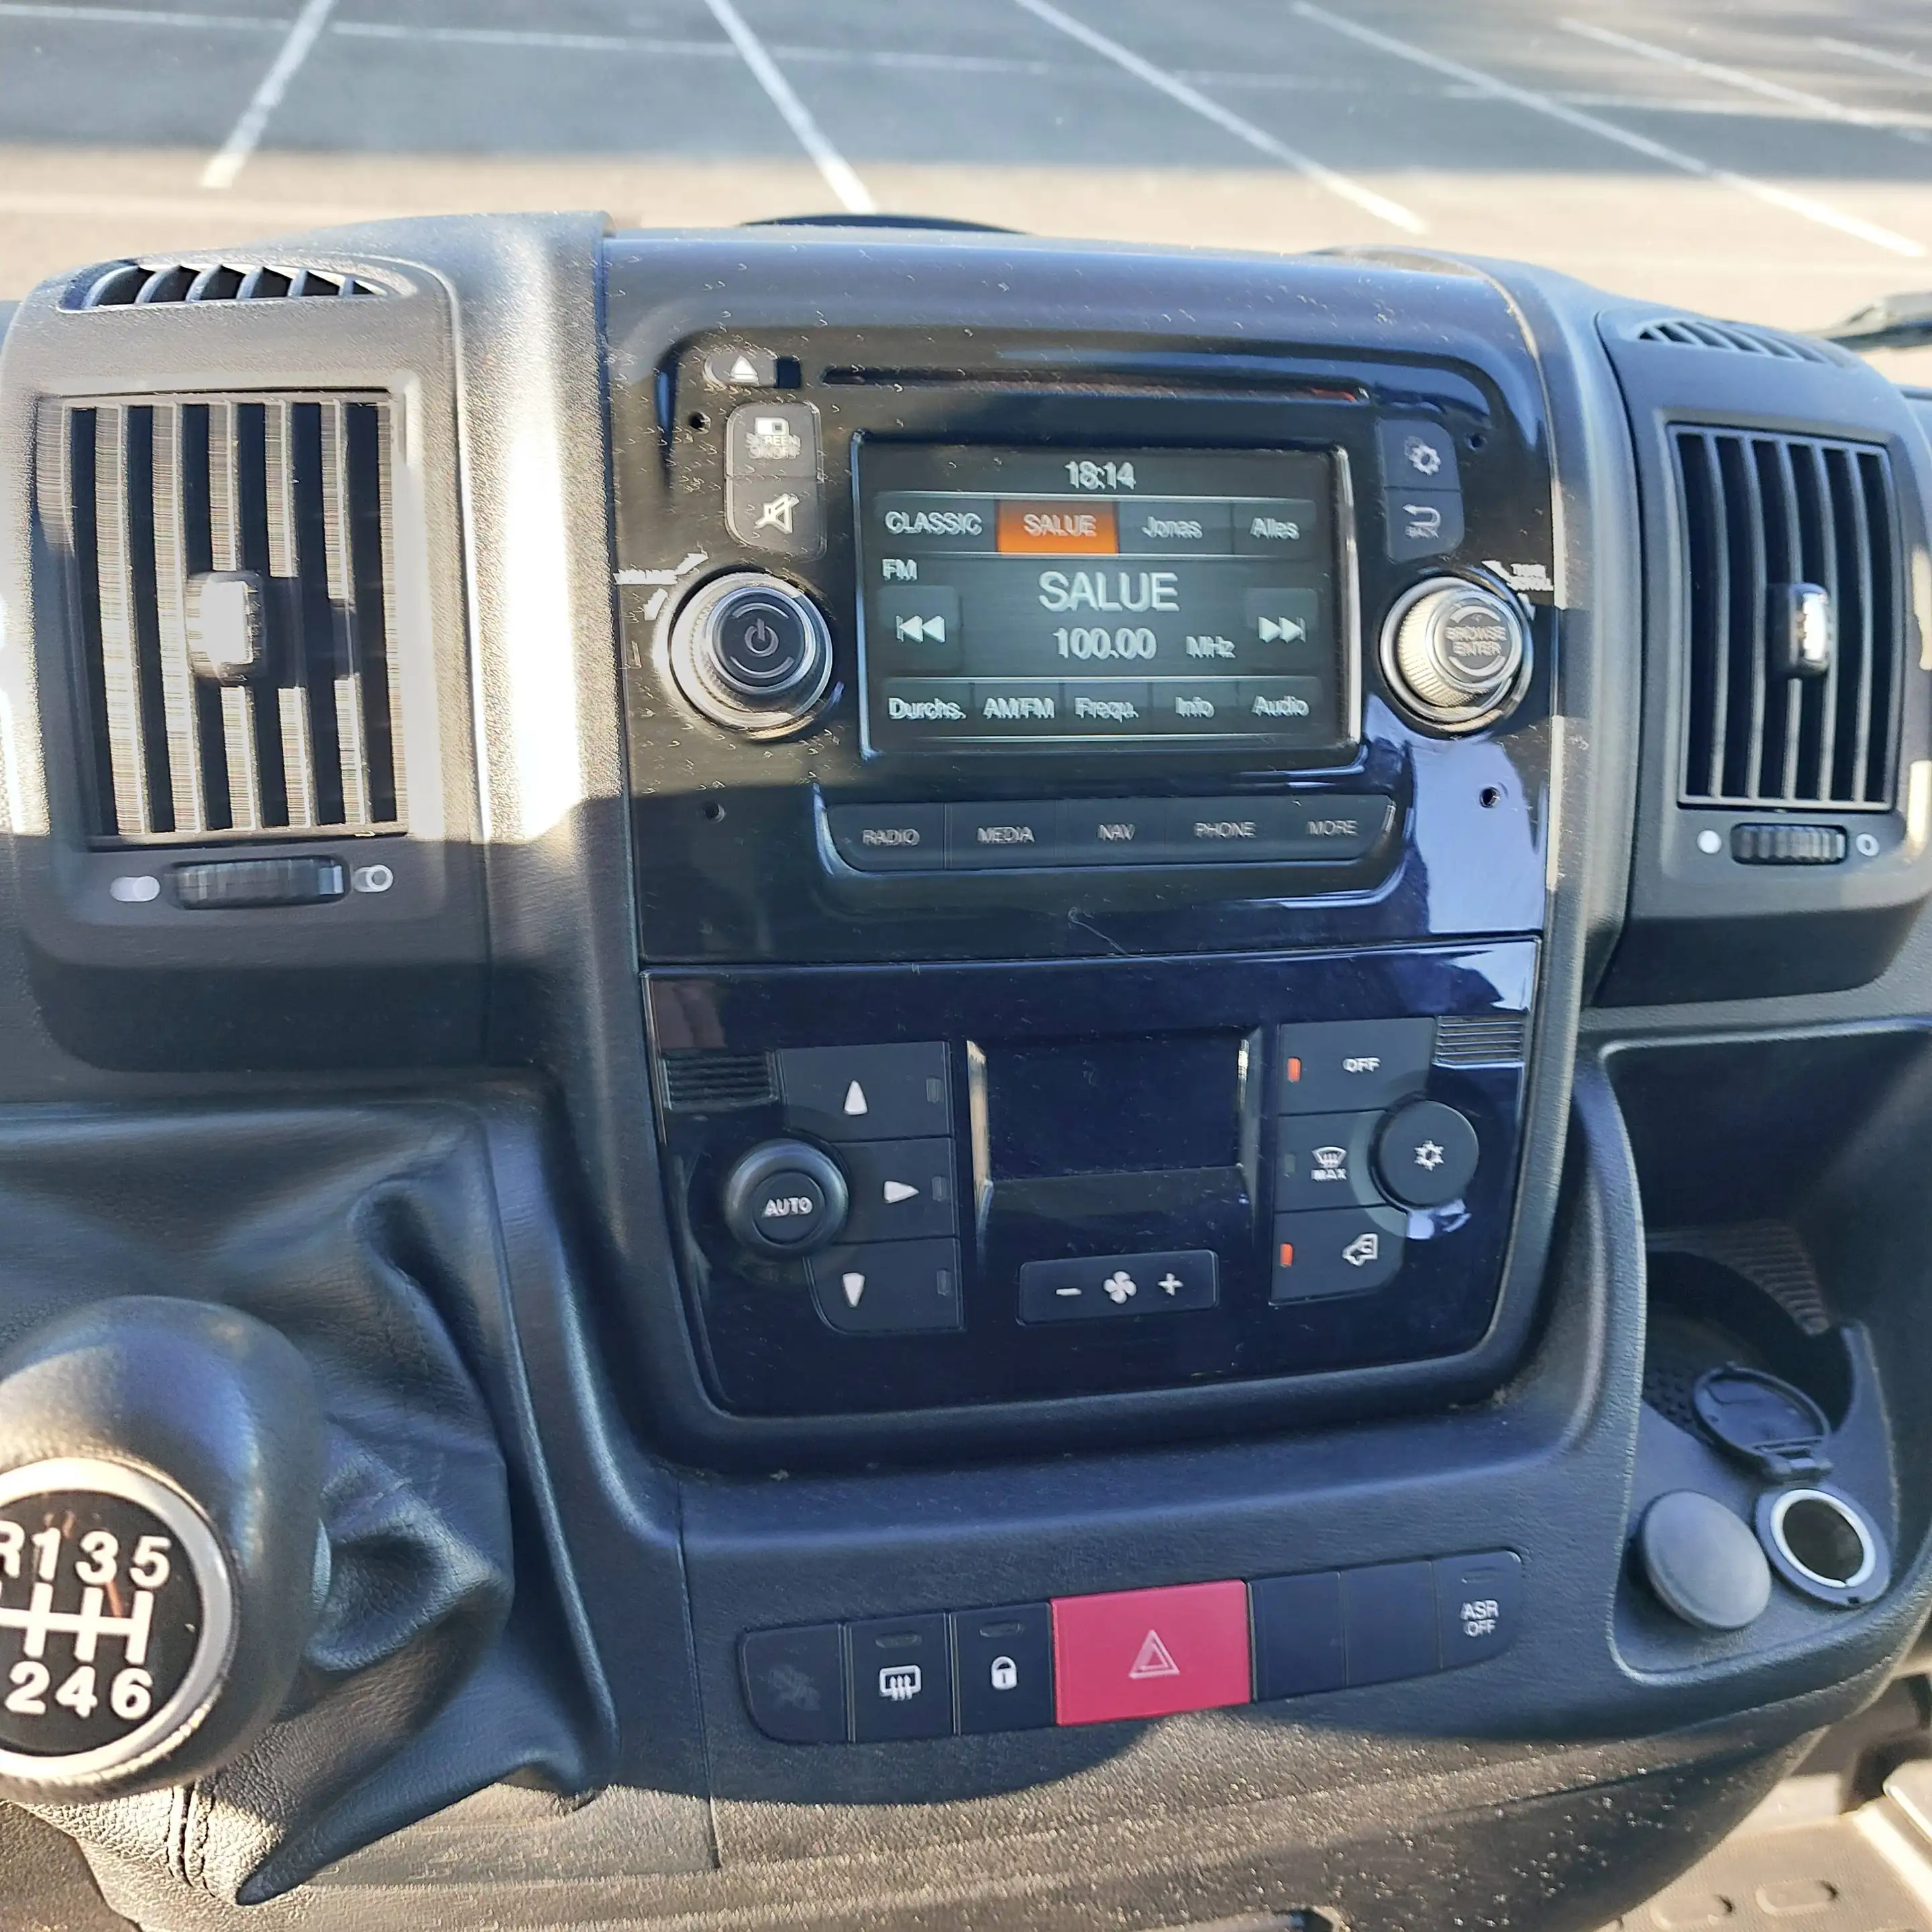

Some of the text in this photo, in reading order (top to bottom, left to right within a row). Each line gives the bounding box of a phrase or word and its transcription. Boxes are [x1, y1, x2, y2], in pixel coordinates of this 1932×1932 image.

[1065, 461, 1136, 490] 18:14
[884, 511, 983, 535] CLASSIC
[1023, 513, 1098, 537] SALUE
[1249, 517, 1300, 539] Alles
[881, 558, 918, 581] FM
[1038, 571, 1180, 612] SALUE
[1053, 627, 1236, 660] 100.00 MHz
[1175, 696, 1215, 718] Info
[1250, 695, 1309, 717] Audio
[862, 828, 920, 846] RADIO
[977, 826, 1036, 845] MEDIA
[1097, 823, 1136, 841] NAV
[1193, 820, 1258, 839] PHONE
[1306, 819, 1359, 837] MORE
[1342, 1057, 1381, 1073] OFF
[1311, 1168, 1347, 1182] MAX
[763, 1196, 813, 1218] AUTO
[32, 1527, 61, 1581] 1
[74, 1530, 119, 1585] 3
[129, 1535, 171, 1589] 5
[1460, 1599, 1499, 1620] ASR
[1464, 1619, 1496, 1637] OFF
[4, 1660, 153, 1720] 2 4 6
